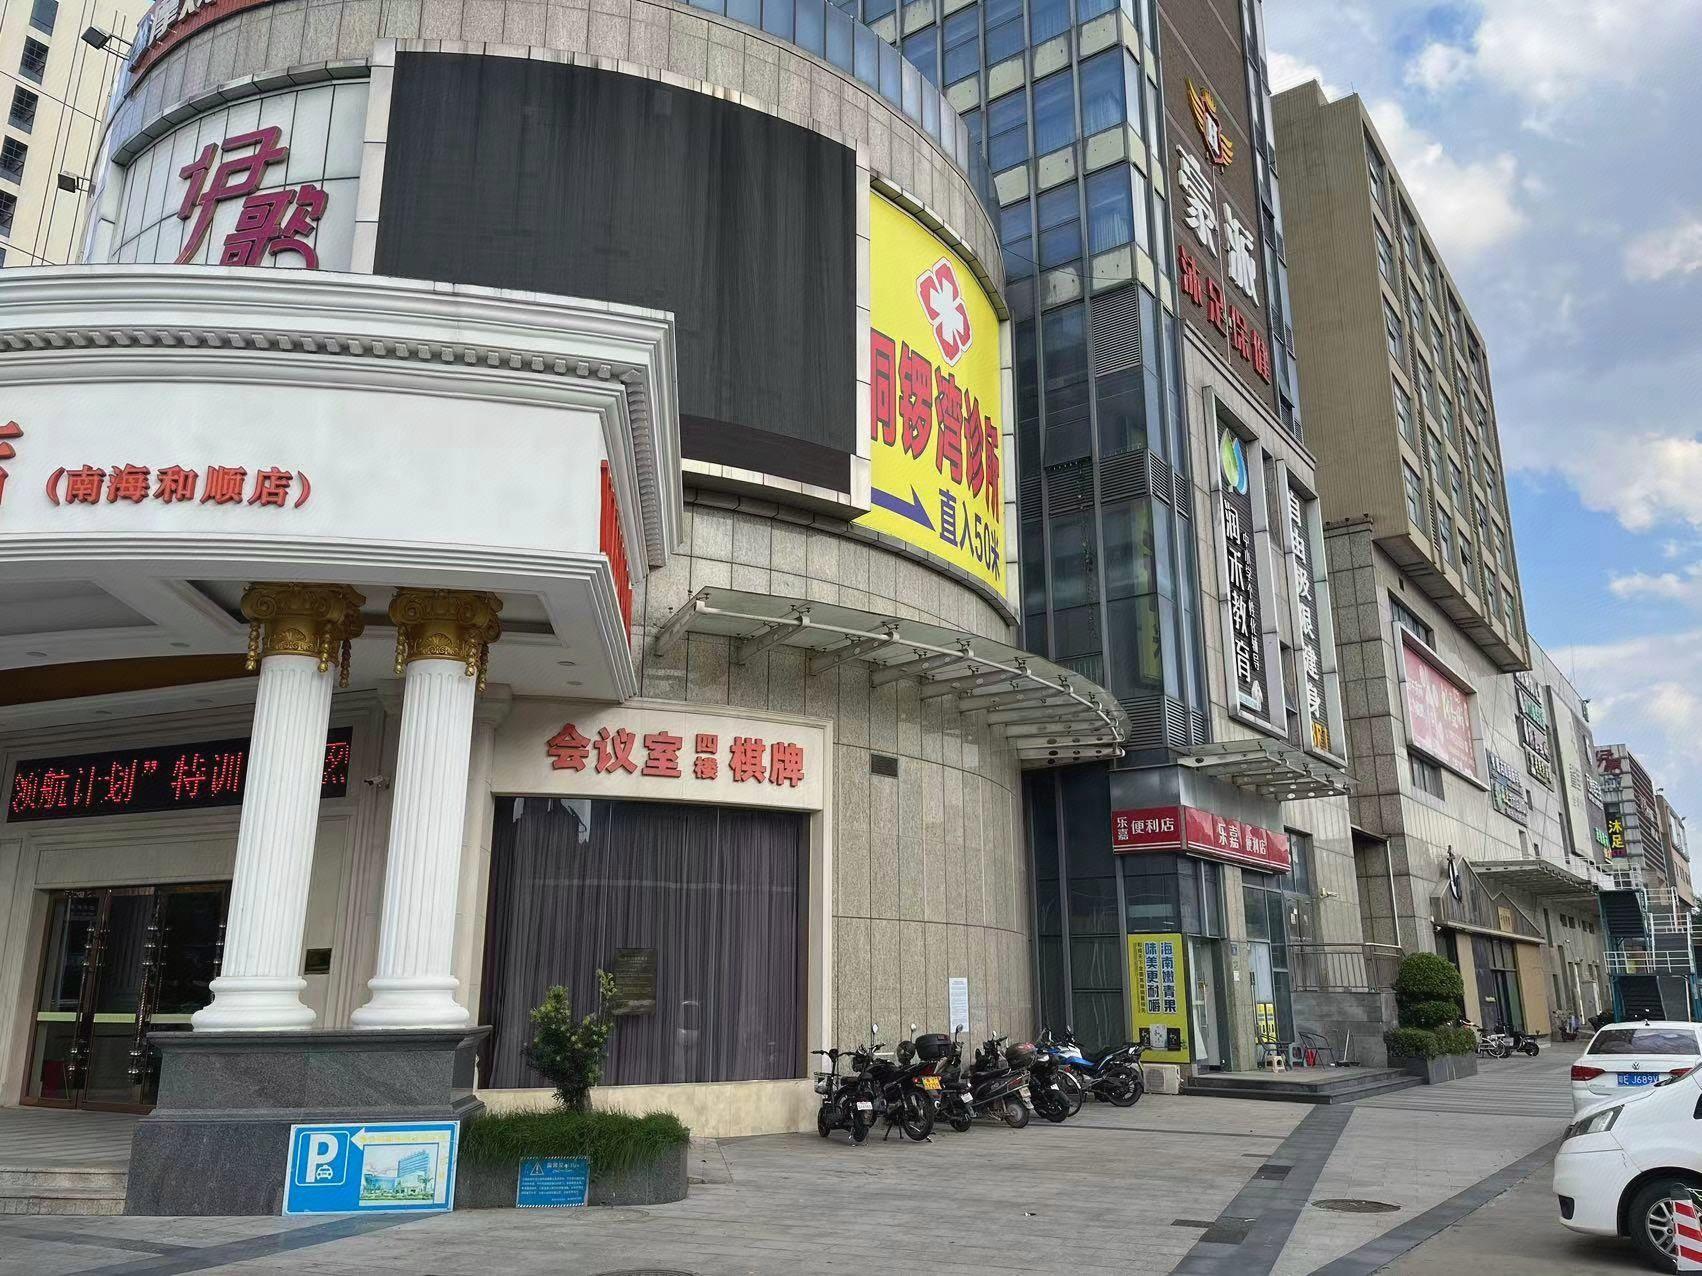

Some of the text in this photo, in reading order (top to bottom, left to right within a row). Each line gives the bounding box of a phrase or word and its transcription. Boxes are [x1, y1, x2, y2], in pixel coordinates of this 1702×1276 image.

[174, 125, 329, 269] 伊歌
[45, 463, 312, 508] (南海和顺店)
[938, 488, 1001, 582] 直入50米
[1224, 500, 1251, 684] 润禾教育
[548, 723, 805, 788] 会议室 四楼 棋牌
[1131, 817, 1175, 835] 便利店
[1217, 823, 1268, 856] 乐嘉 便利店
[1608, 820, 1625, 849] 沐足
[1144, 941, 1161, 1013] 味美更耐嚼
[306, 1134, 339, 1183] P
